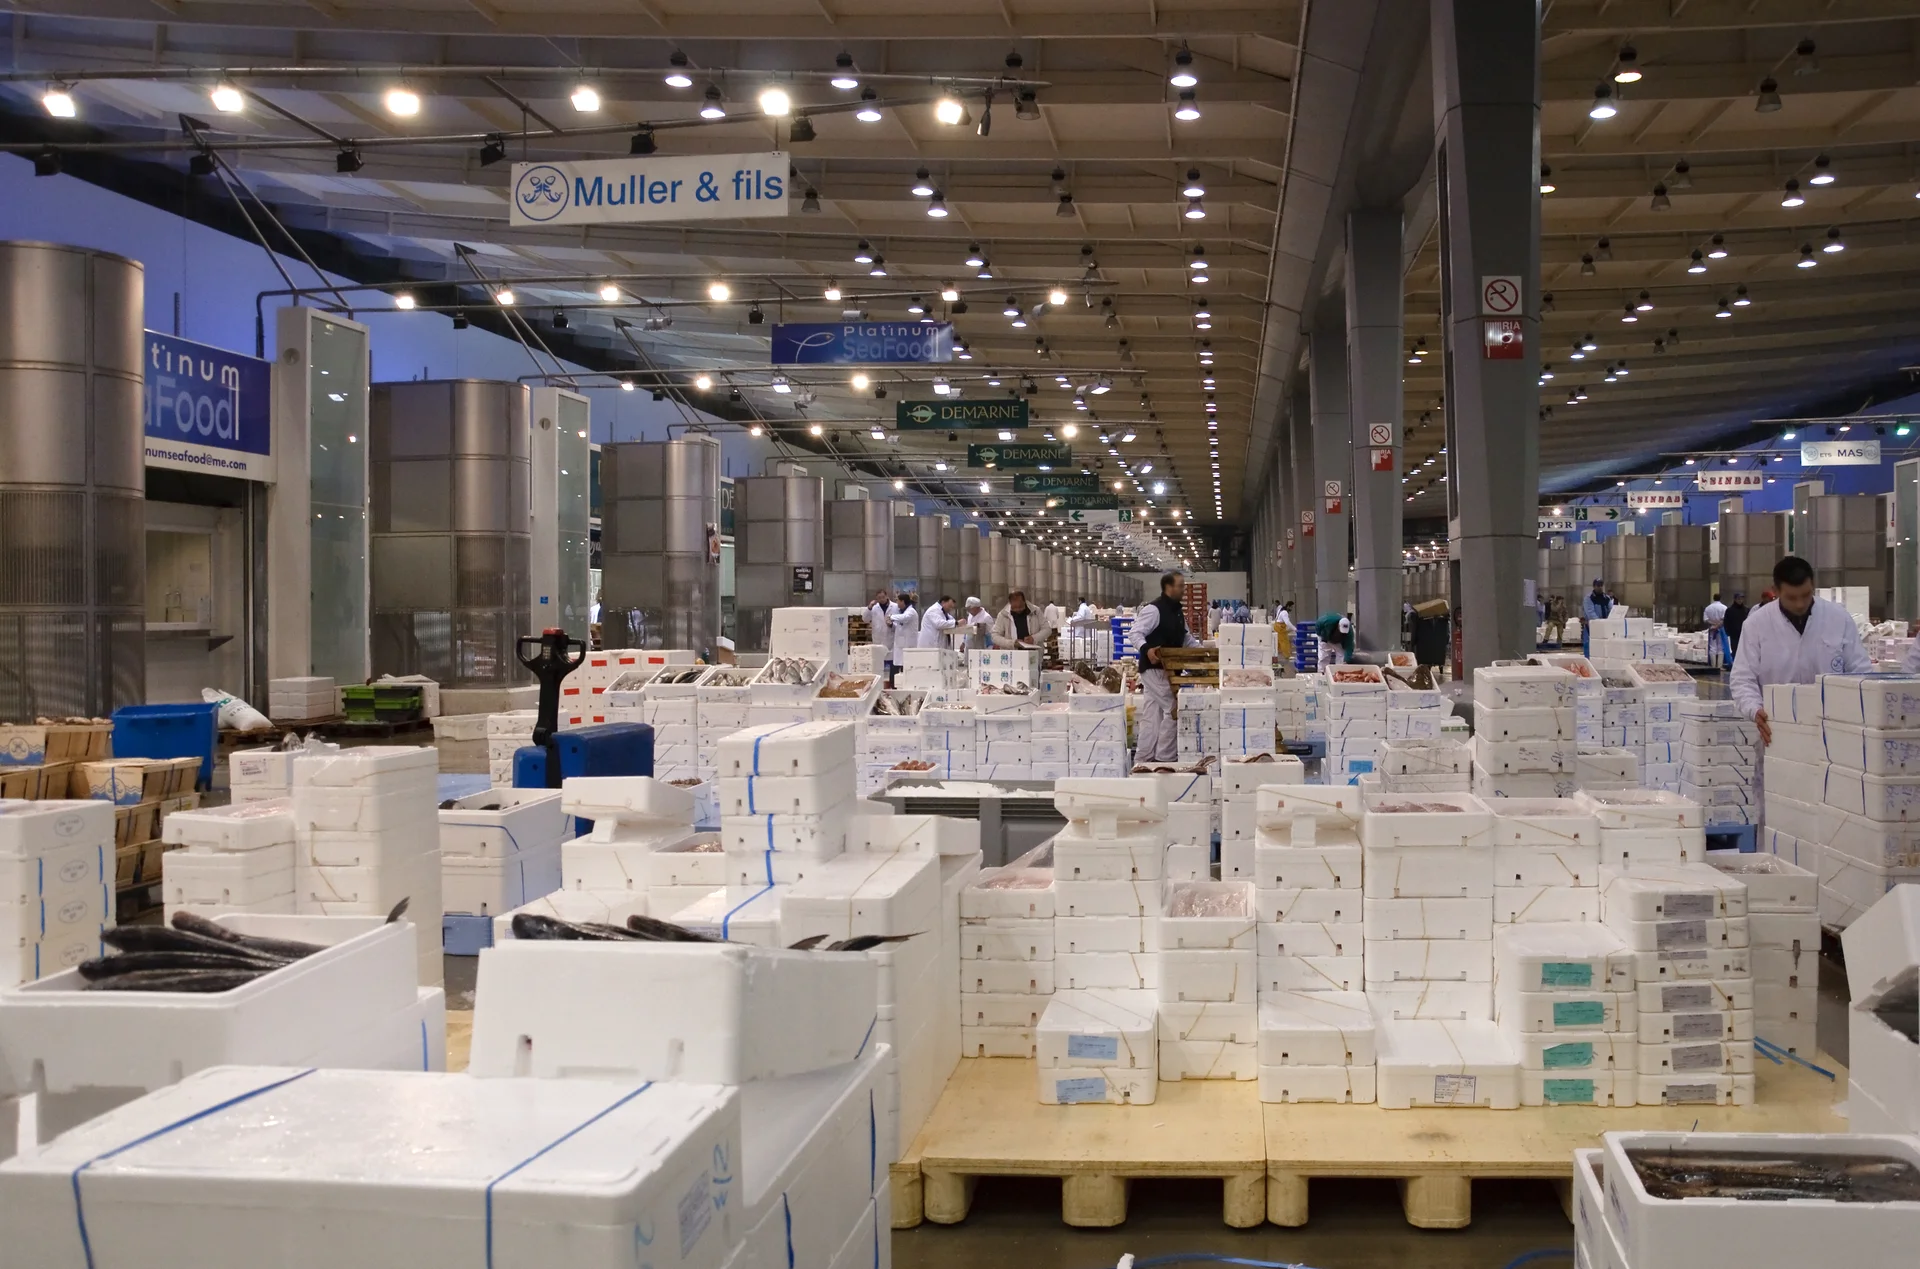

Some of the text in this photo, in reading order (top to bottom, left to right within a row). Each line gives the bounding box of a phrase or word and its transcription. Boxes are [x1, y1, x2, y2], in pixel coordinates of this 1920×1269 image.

[574, 169, 784, 207] Muller & fils
[1502, 321, 1521, 330] RIA
[843, 325, 939, 337] Platinum
[843, 337, 938, 359] SeaFood
[941, 405, 1020, 420] DEMARNE
[1002, 449, 1065, 460] DEMARNE
[1837, 448, 1864, 458] MAS
[1042, 477, 1094, 487] DEMARNE
[1709, 476, 1761, 486] SINBAD
[1069, 497, 1115, 505] DEMARNE
[1636, 495, 1681, 504] SINBAD
